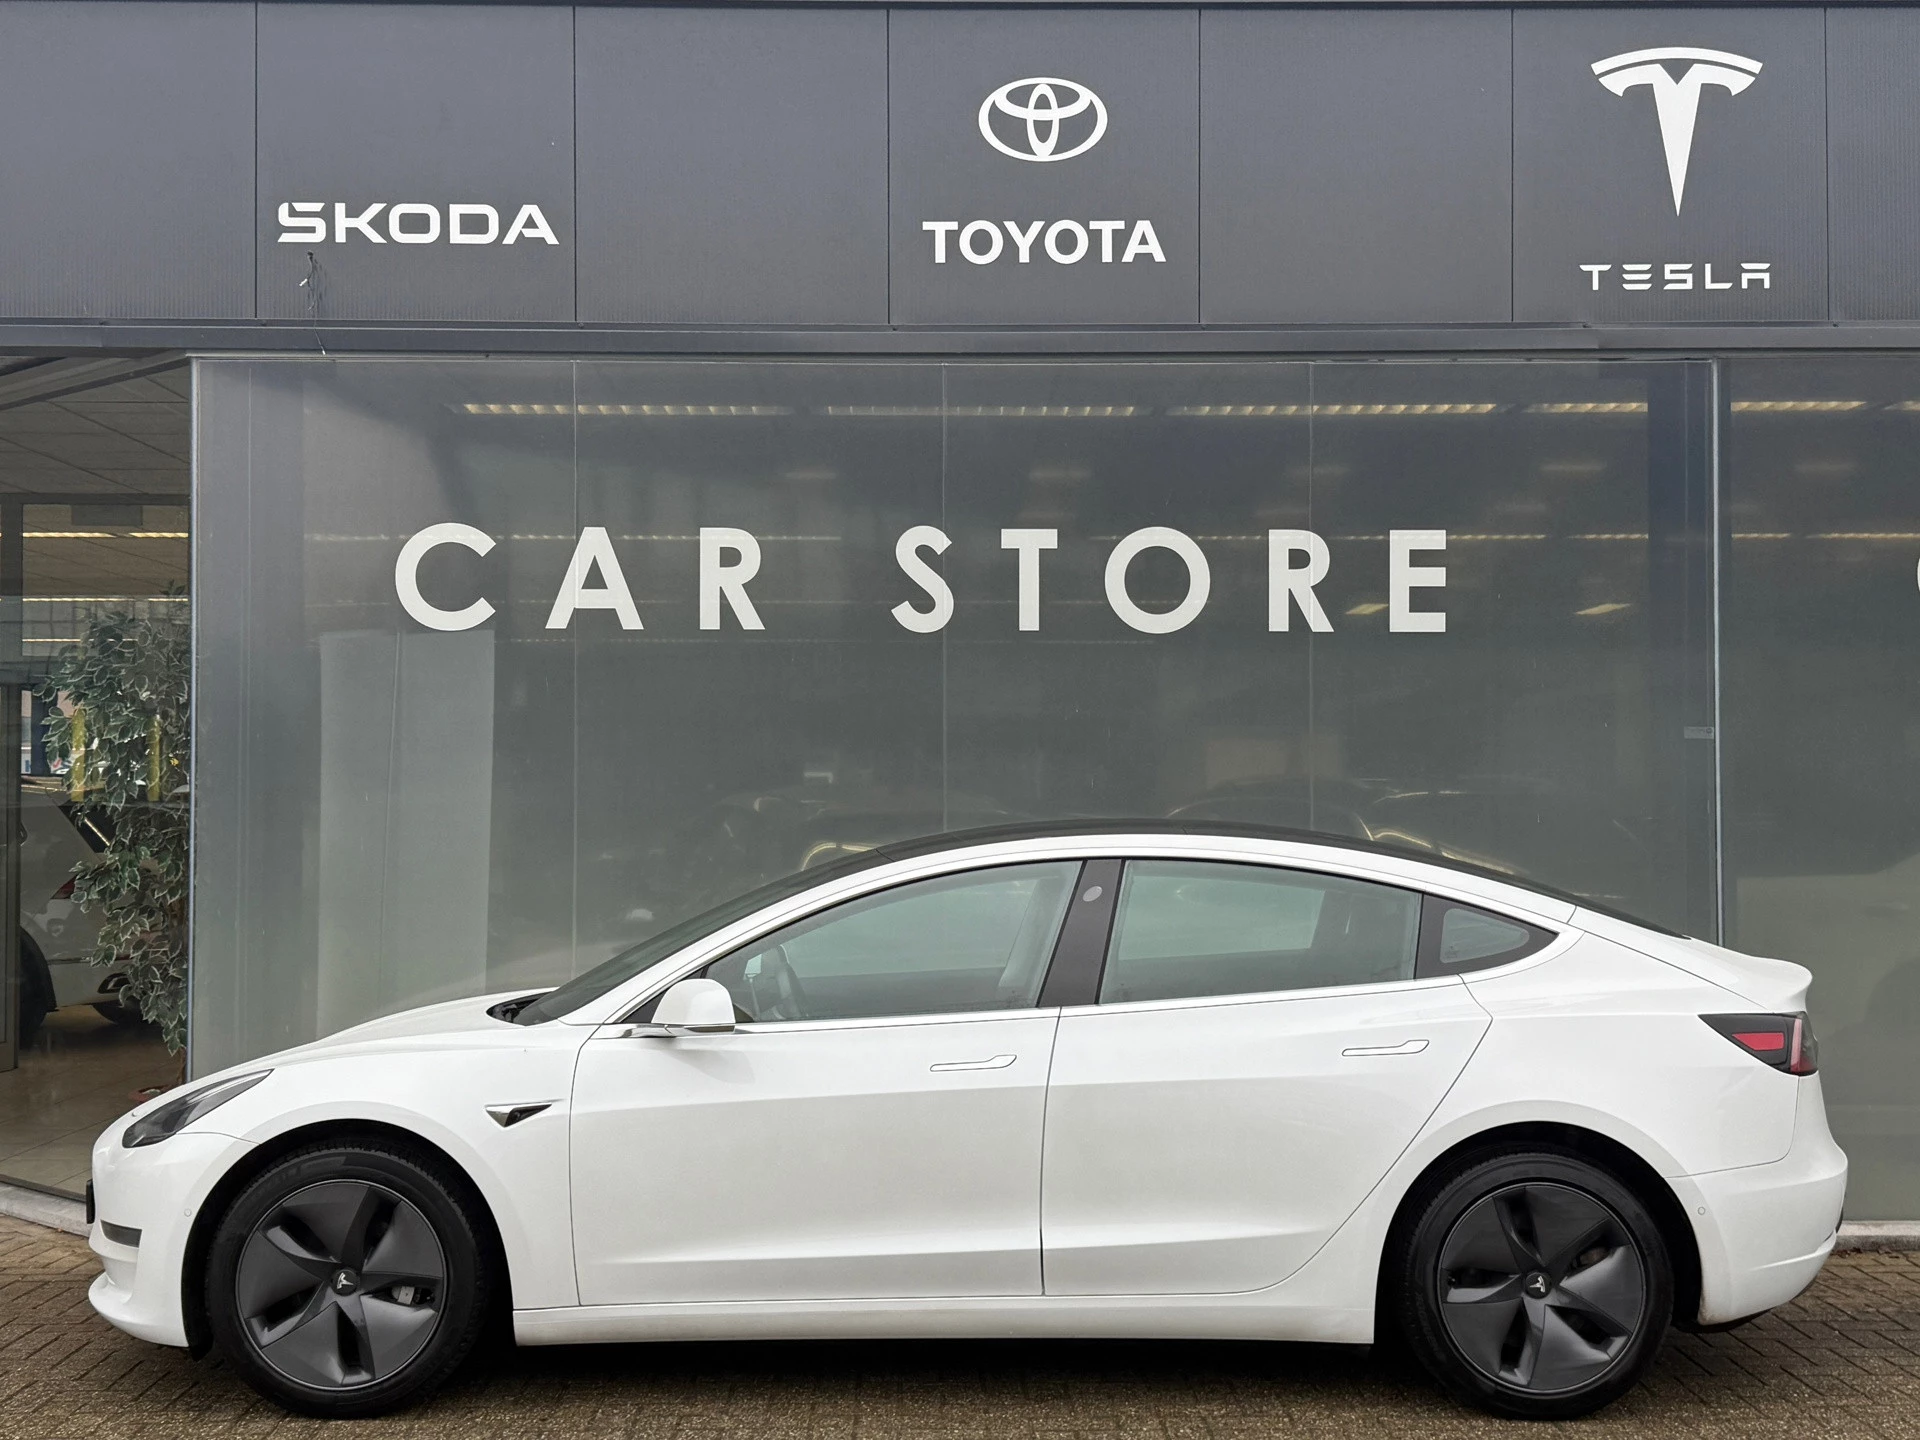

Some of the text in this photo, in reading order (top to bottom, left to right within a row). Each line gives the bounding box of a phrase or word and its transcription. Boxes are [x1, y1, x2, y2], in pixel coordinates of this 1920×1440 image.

[277, 201, 560, 245] SKODA
[921, 219, 1167, 265] TOYOTA
[1579, 262, 1772, 291] TESLA
[395, 522, 1448, 634] CAR STORE
